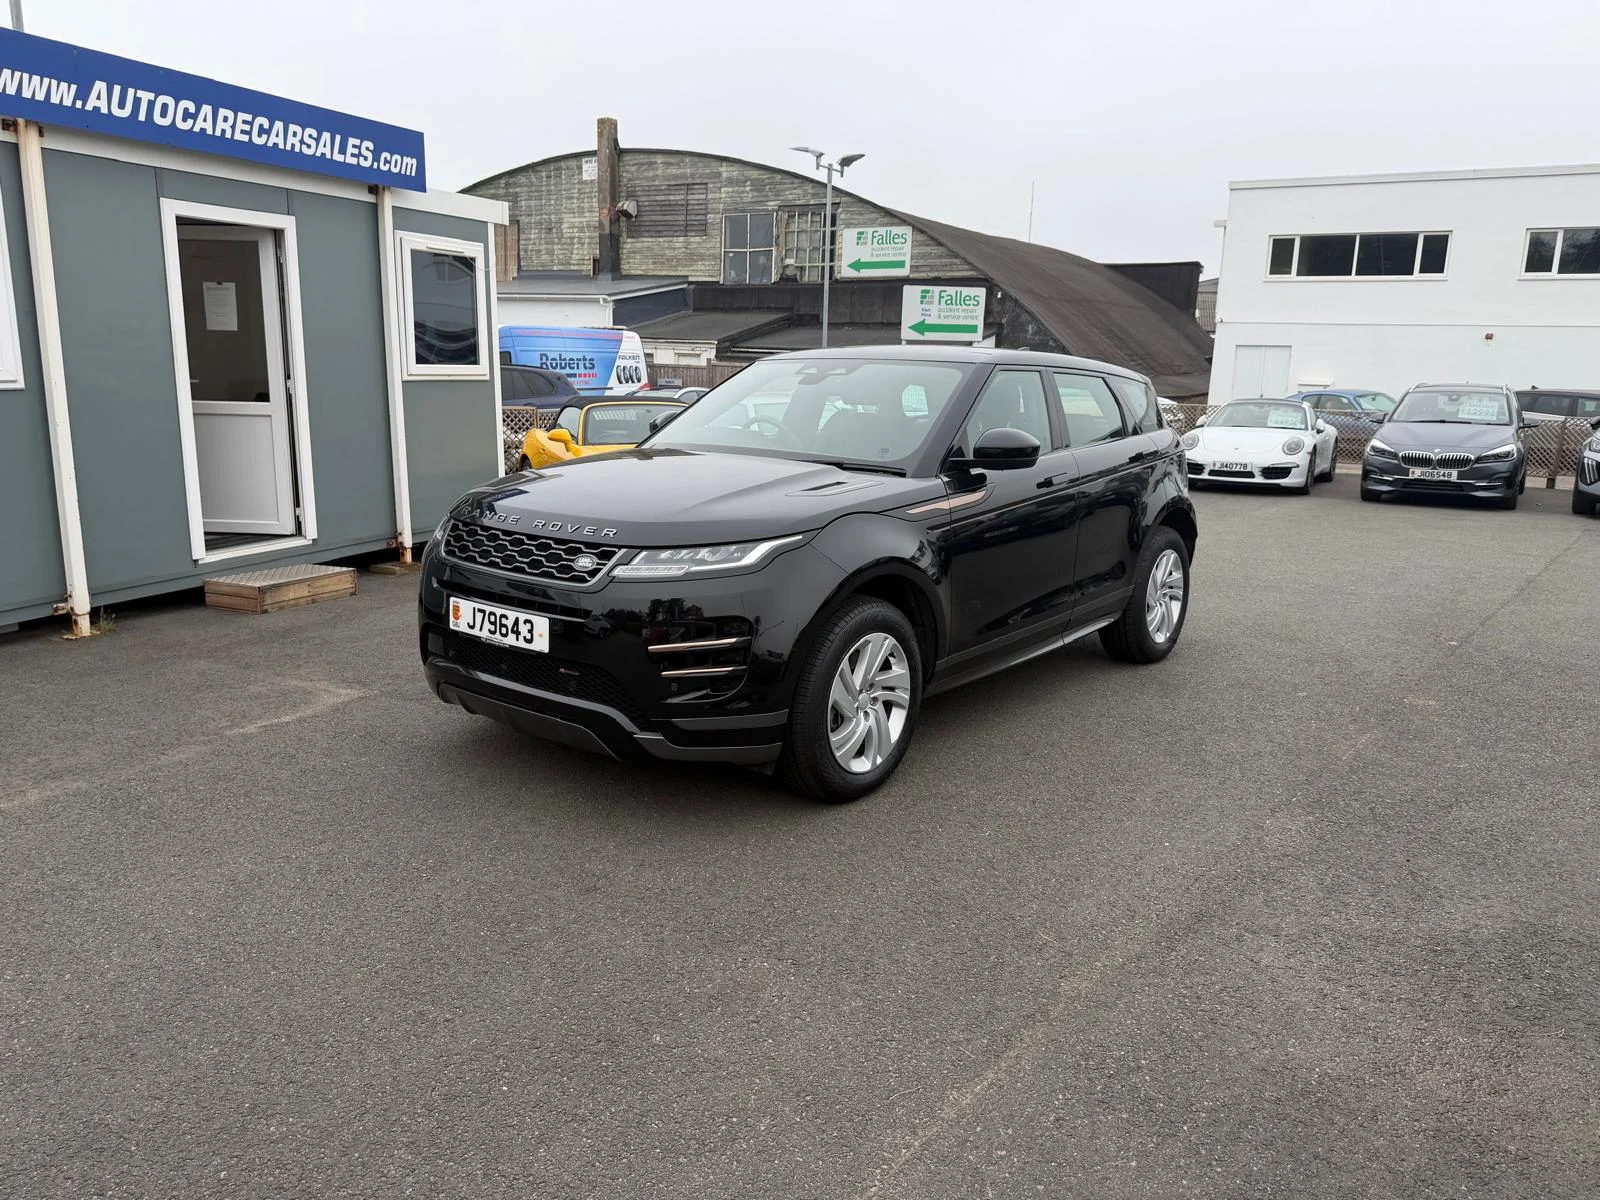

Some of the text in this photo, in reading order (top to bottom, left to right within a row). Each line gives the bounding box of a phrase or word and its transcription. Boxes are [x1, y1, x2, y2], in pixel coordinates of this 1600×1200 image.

[0, 68, 417, 177] www.AUTOCARECARSALES.com
[871, 230, 907, 245] Falles
[938, 290, 980, 306] Falles
[539, 352, 596, 370] Roberts
[1417, 470, 1453, 479] J106548
[461, 506, 618, 538] RANGE ROVER
[467, 606, 534, 645] J79643
